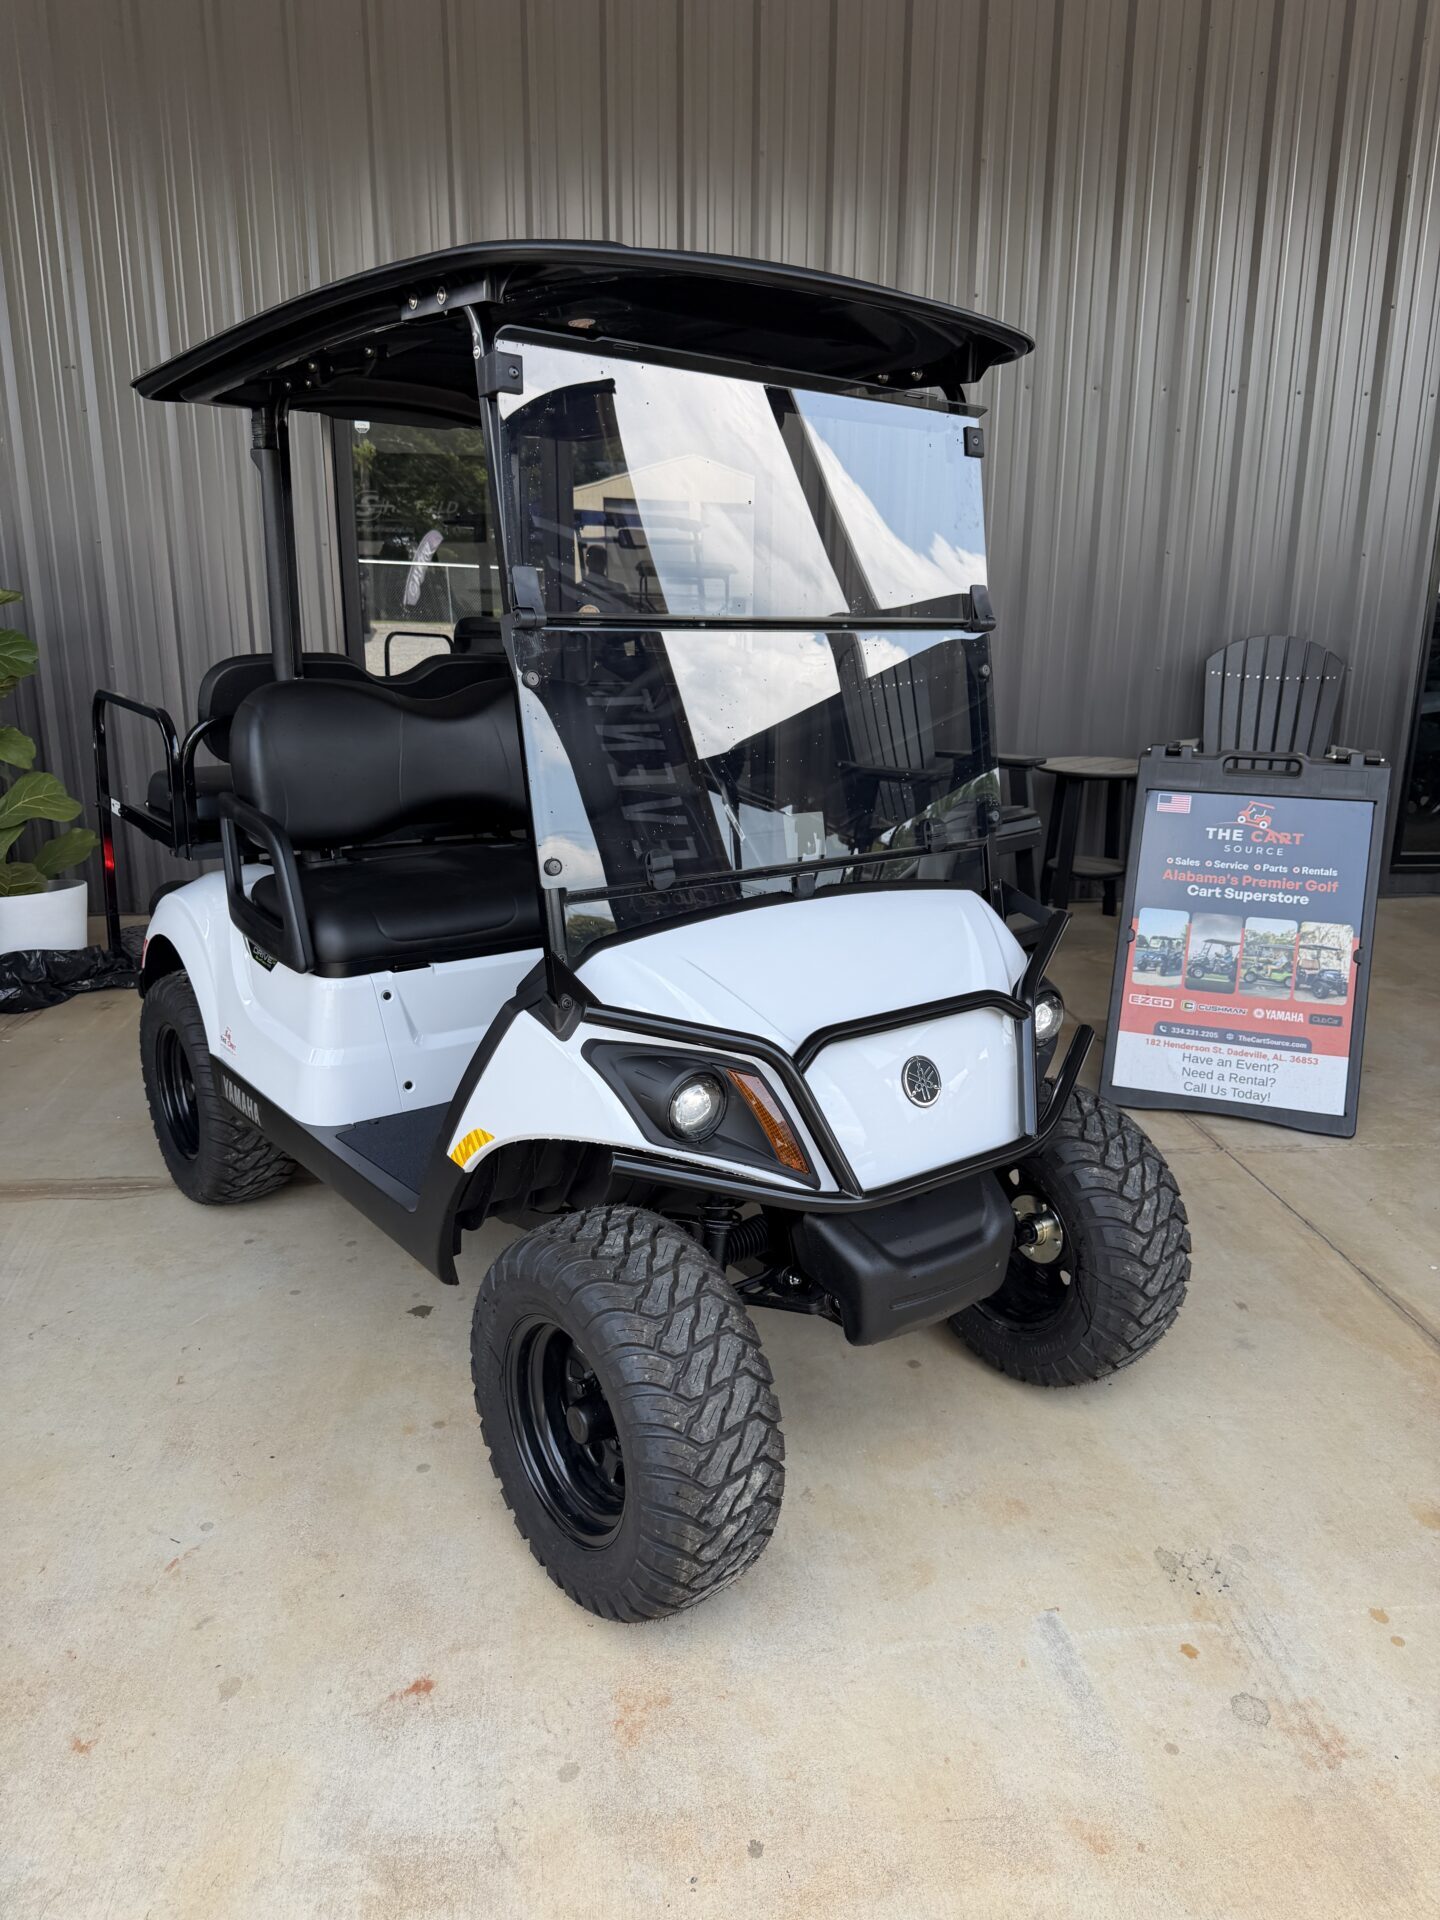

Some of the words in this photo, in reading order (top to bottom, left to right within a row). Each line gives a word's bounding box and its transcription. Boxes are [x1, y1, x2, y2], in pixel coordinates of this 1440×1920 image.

[1205, 827, 1244, 842] THE
[1250, 829, 1305, 846] CART
[1223, 844, 1285, 856] SOURCE
[1175, 857, 1201, 867] Sales
[1213, 859, 1249, 871] Service
[1262, 863, 1289, 874] Parts
[1301, 866, 1339, 877] Rentals
[1162, 868, 1239, 886] Alabama's
[1242, 875, 1303, 890] Premier
[1304, 879, 1339, 893] Golf
[1187, 884, 1222, 898] Cart
[1224, 886, 1310, 905] Superstore
[1198, 1003, 1247, 1015] CUSHMAN
[1265, 1009, 1304, 1023] YAMAHA
[1146, 1038, 1161, 1047] 182
[1163, 1041, 1210, 1053] Henderson
[1212, 1046, 1225, 1055] St.
[1226, 1048, 1270, 1061] Dadeville,
[1289, 1055, 1319, 1066] 36853
[1238, 1034, 1308, 1049] TheCartSource.com
[1182, 1052, 1214, 1066] Have
[1216, 1058, 1232, 1068] an
[1236, 1059, 1280, 1073] Event?
[1181, 1066, 1214, 1080] Need
[1217, 1072, 1225, 1081] a
[1228, 1072, 1277, 1088] Rental?
[222, 1074, 262, 1128] YAMAHA
[1183, 1081, 1207, 1093] Call
[1210, 1085, 1228, 1096] Us
[1230, 1087, 1271, 1104] Today!
